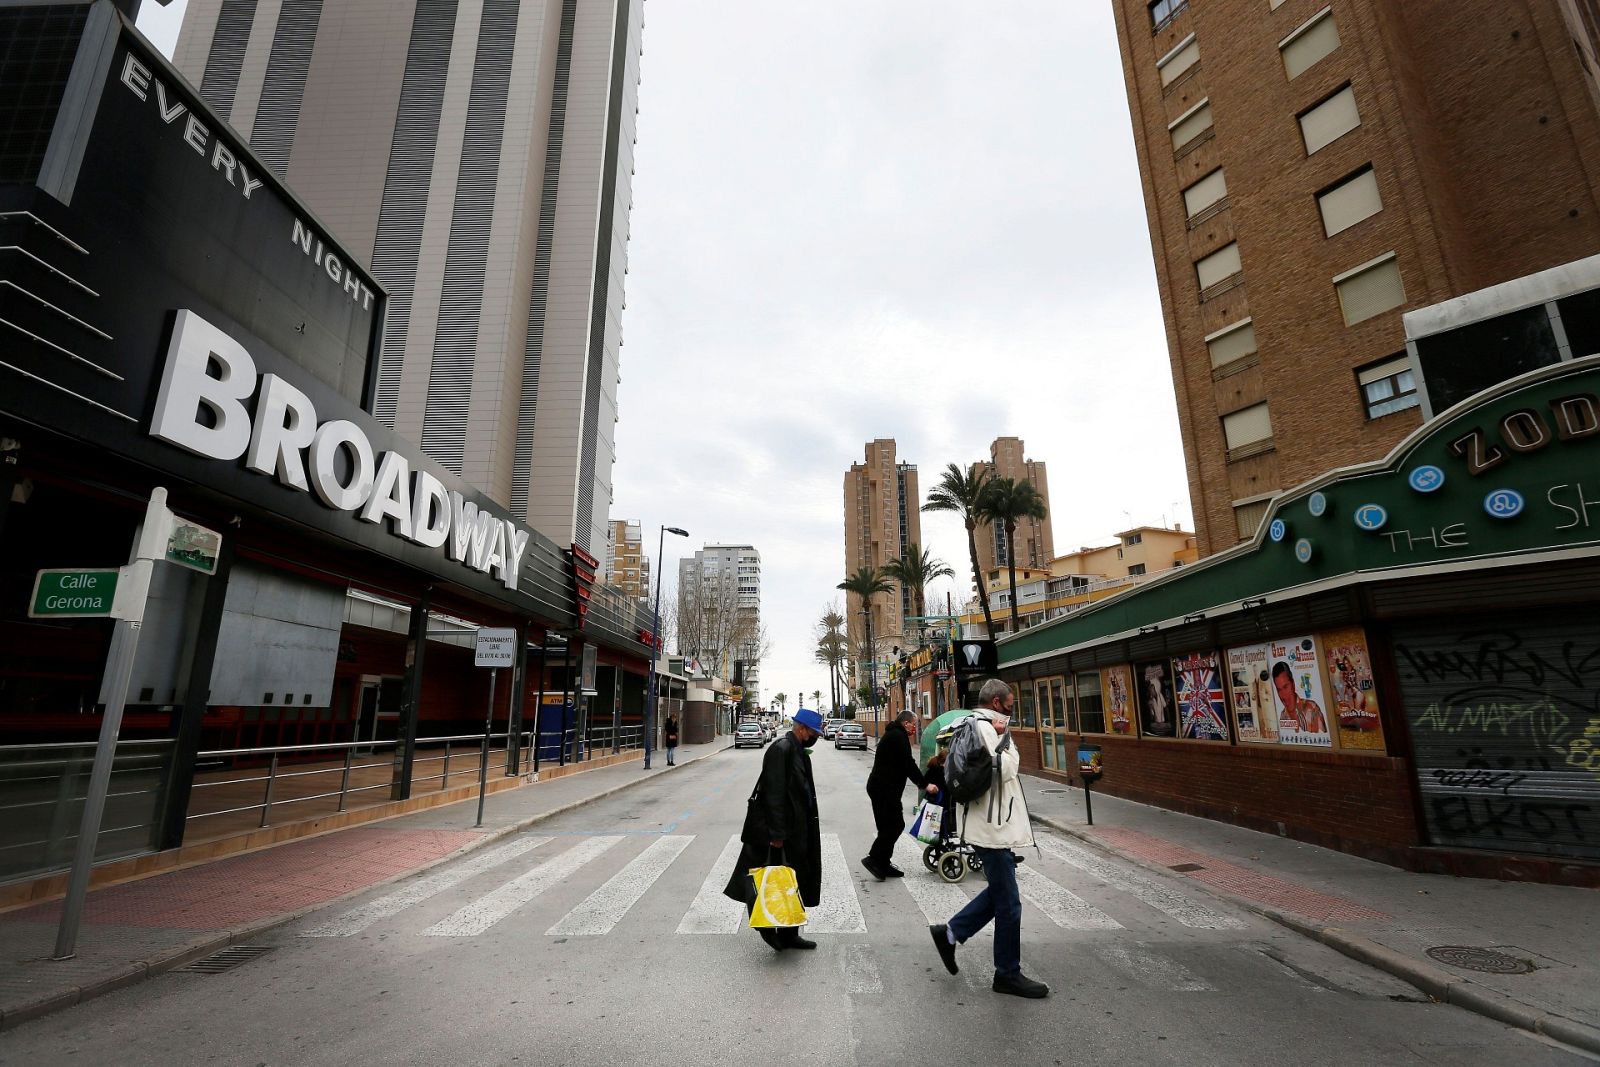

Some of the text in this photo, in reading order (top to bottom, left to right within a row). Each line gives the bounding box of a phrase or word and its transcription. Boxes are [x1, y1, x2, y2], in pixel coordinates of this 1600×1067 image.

[120, 51, 375, 311] EVERY NIGHT
[149, 308, 529, 591] BROADWAY
[1379, 523, 1469, 553] THE
[59, 575, 97, 589] Calle
[45, 595, 103, 609] Gerona
